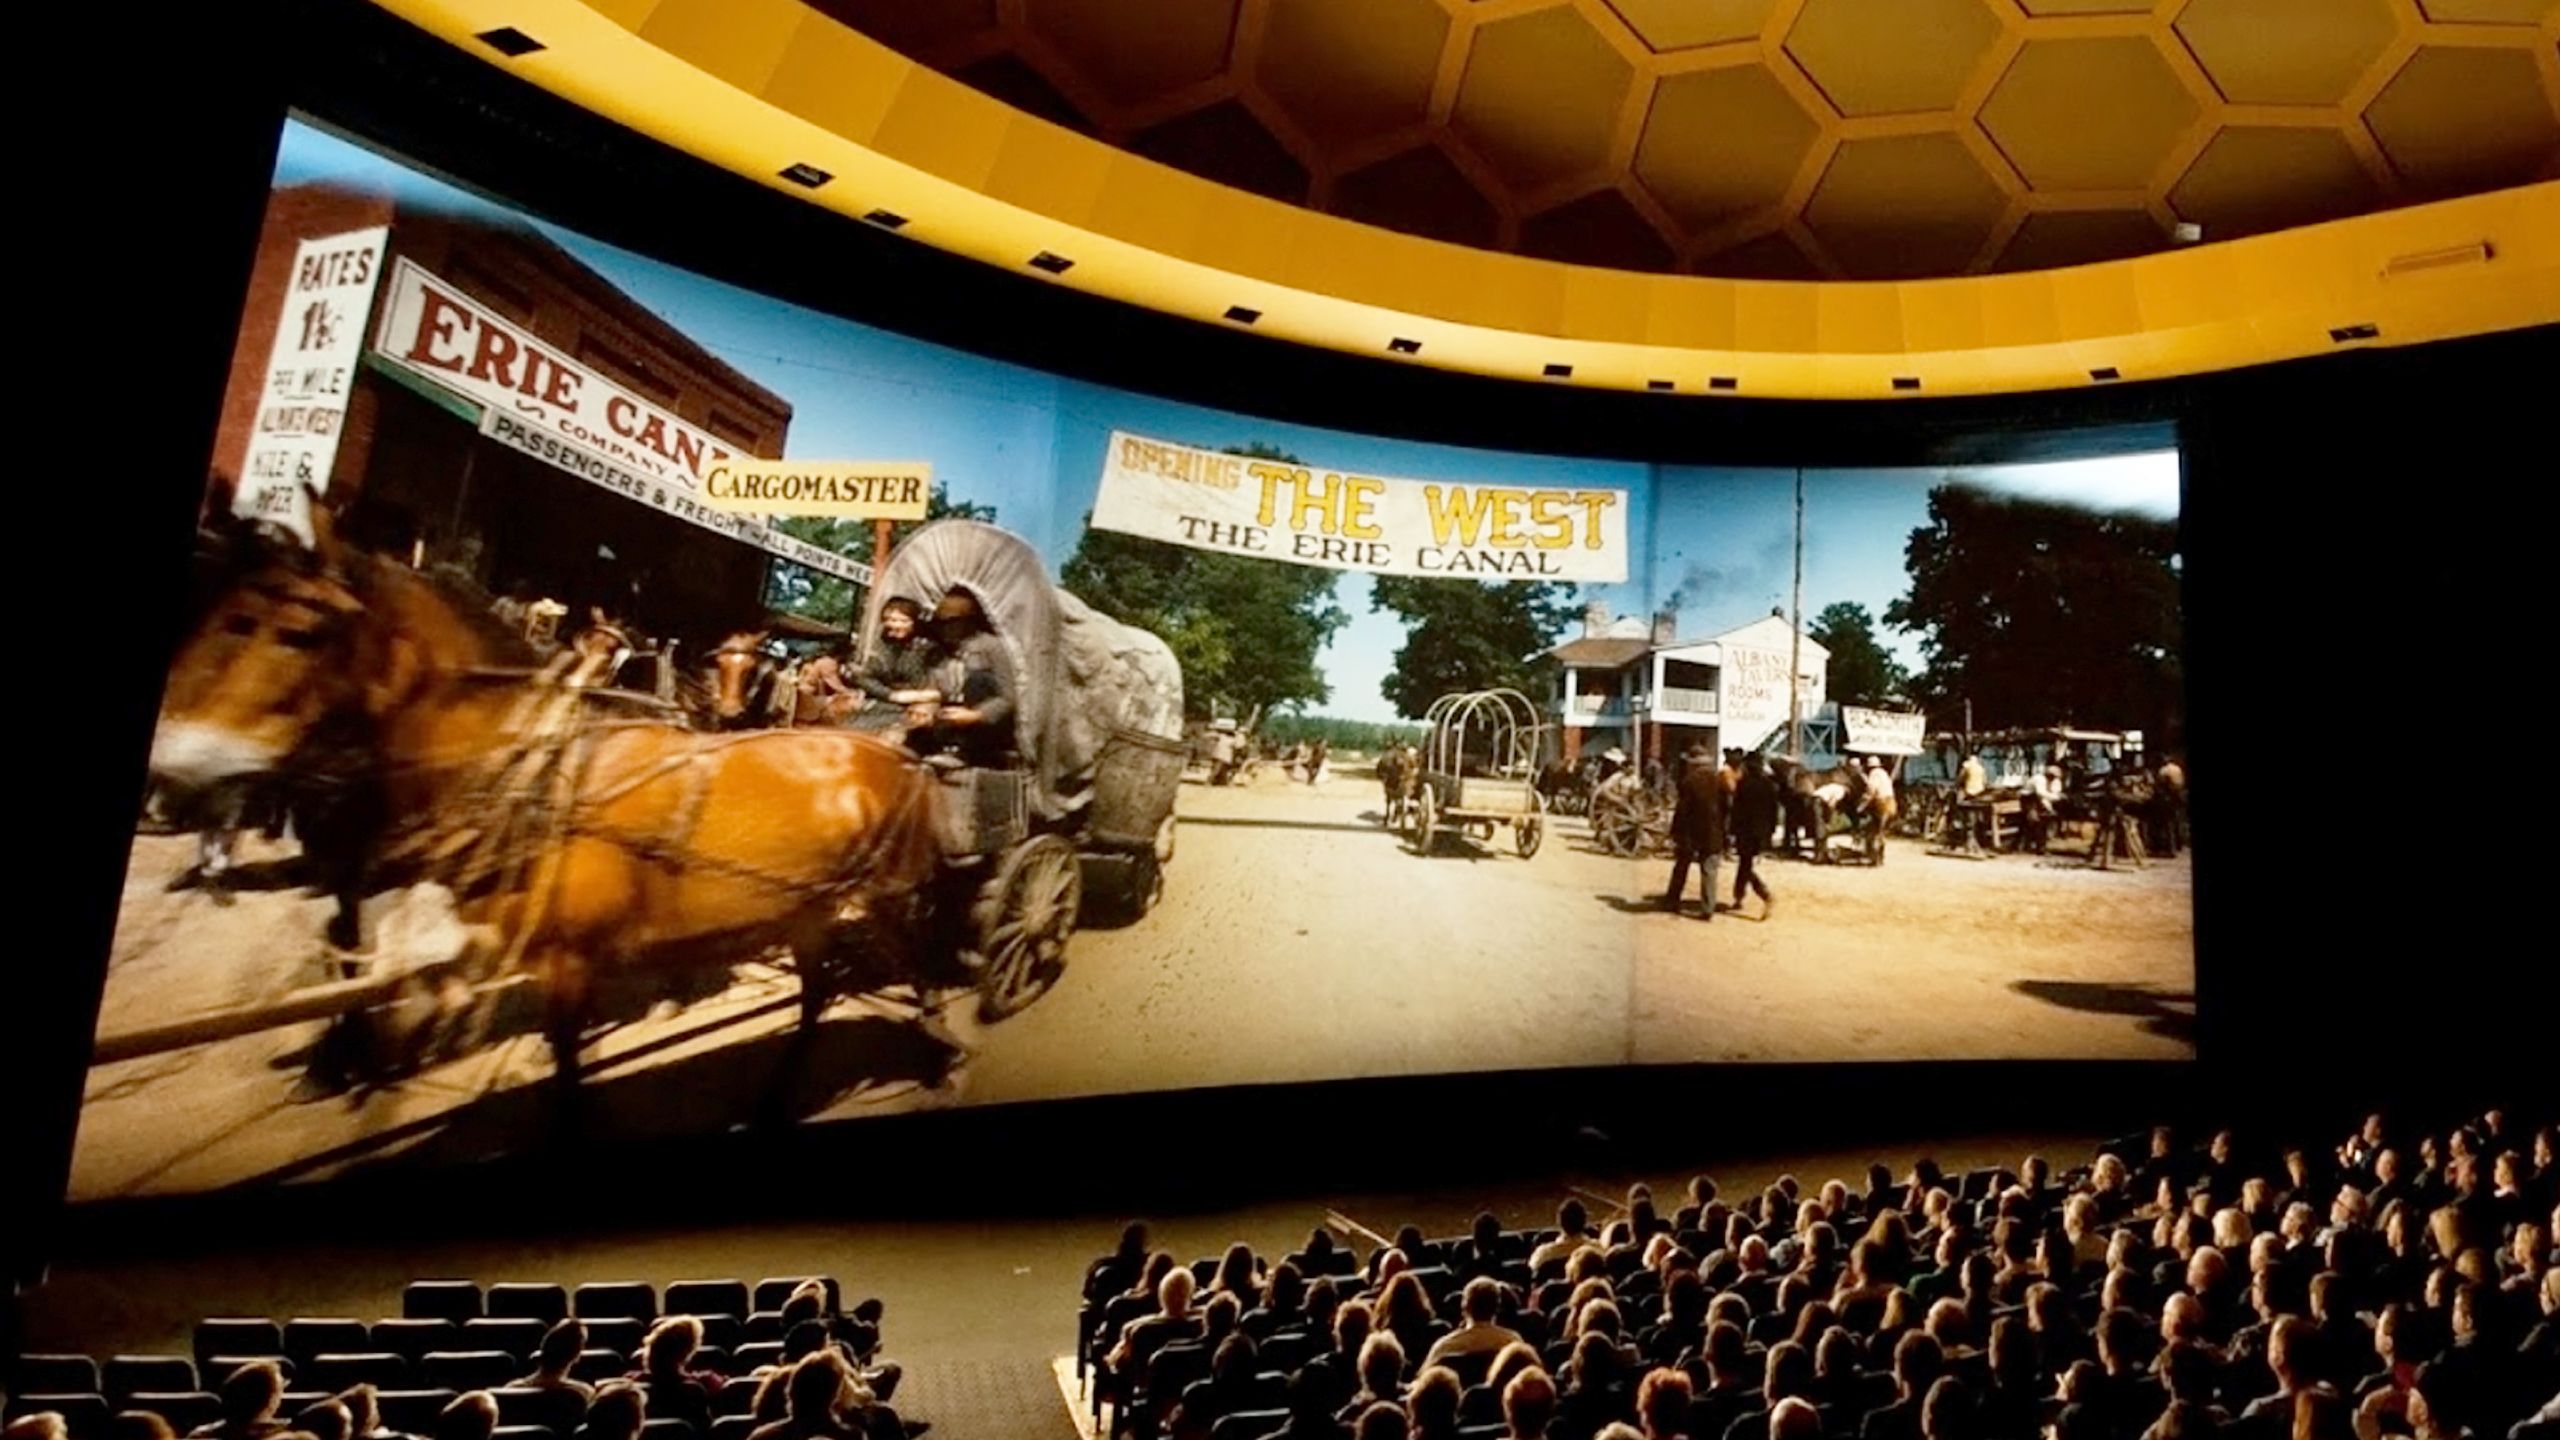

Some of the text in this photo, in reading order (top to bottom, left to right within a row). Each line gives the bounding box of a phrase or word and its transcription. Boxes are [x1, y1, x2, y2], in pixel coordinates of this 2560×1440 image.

[298, 247, 375, 291] RATES
[407, 284, 729, 480] ERIE CAN
[558, 418, 668, 476] COMPANY
[494, 415, 647, 497] PASSENGERS
[652, 488, 667, 505] &
[674, 495, 747, 536] FREIGHT
[795, 544, 841, 572] POINTS
[846, 565, 872, 583] WES
[706, 467, 923, 505] CARGOMASTER
[1119, 437, 1616, 550] OPENING THE WEST
[1178, 515, 1562, 574] THE ERIE CANAL
